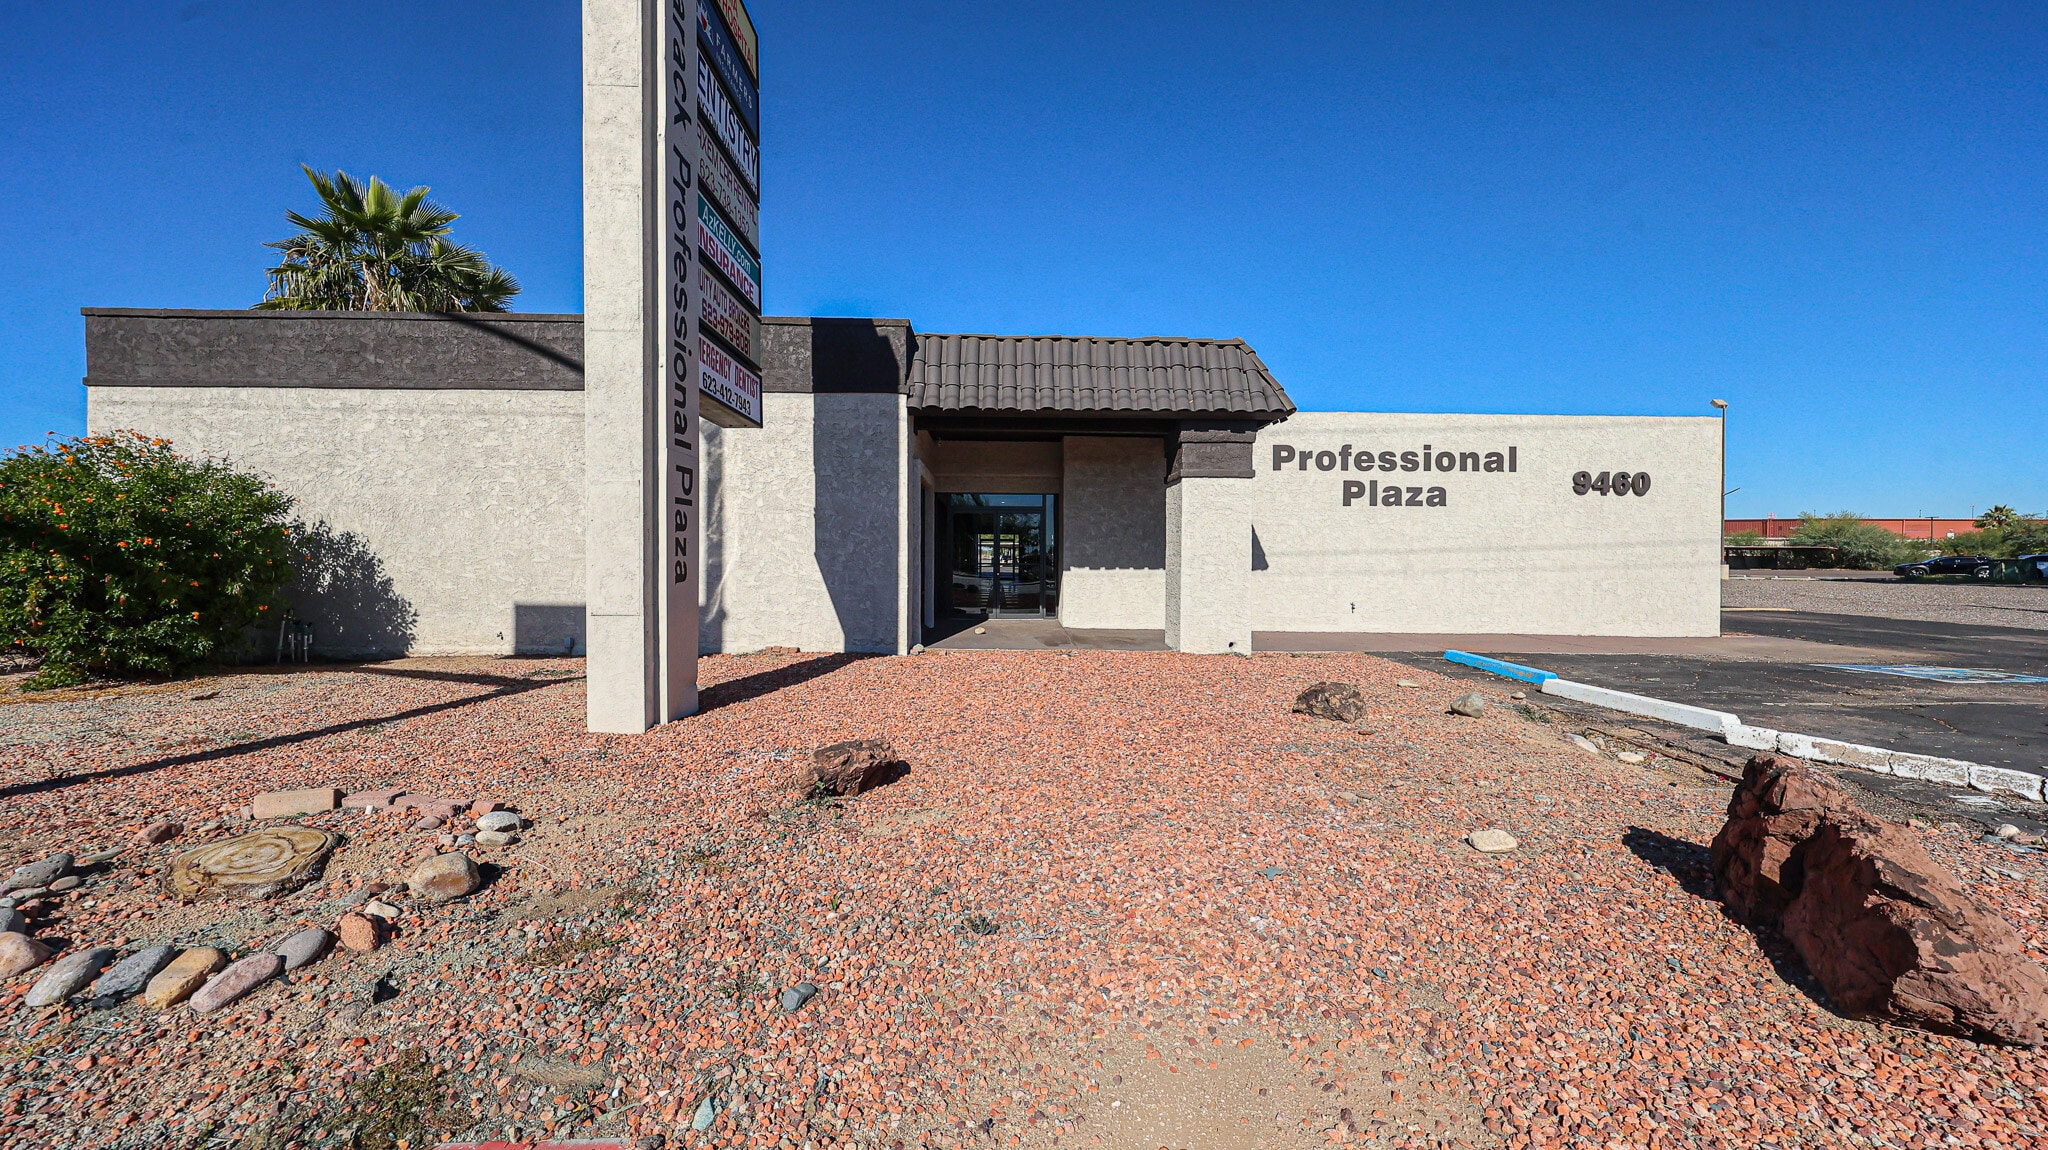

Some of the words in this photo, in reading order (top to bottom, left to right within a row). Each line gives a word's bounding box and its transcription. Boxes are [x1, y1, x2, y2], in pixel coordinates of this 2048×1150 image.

[716, 33, 752, 109] FARMERS
[698, 222, 754, 301] INSURANCE
[673, 143, 692, 451] Professional
[698, 267, 712, 299] UITY
[713, 283, 728, 313] AUTO
[703, 371, 751, 415] 623-412-7943
[735, 365, 758, 400] DENTIST
[1272, 444, 1517, 473] Professional
[1342, 480, 1447, 508] Plaza
[1572, 471, 1652, 497] 9460
[674, 464, 693, 585] Plaza
